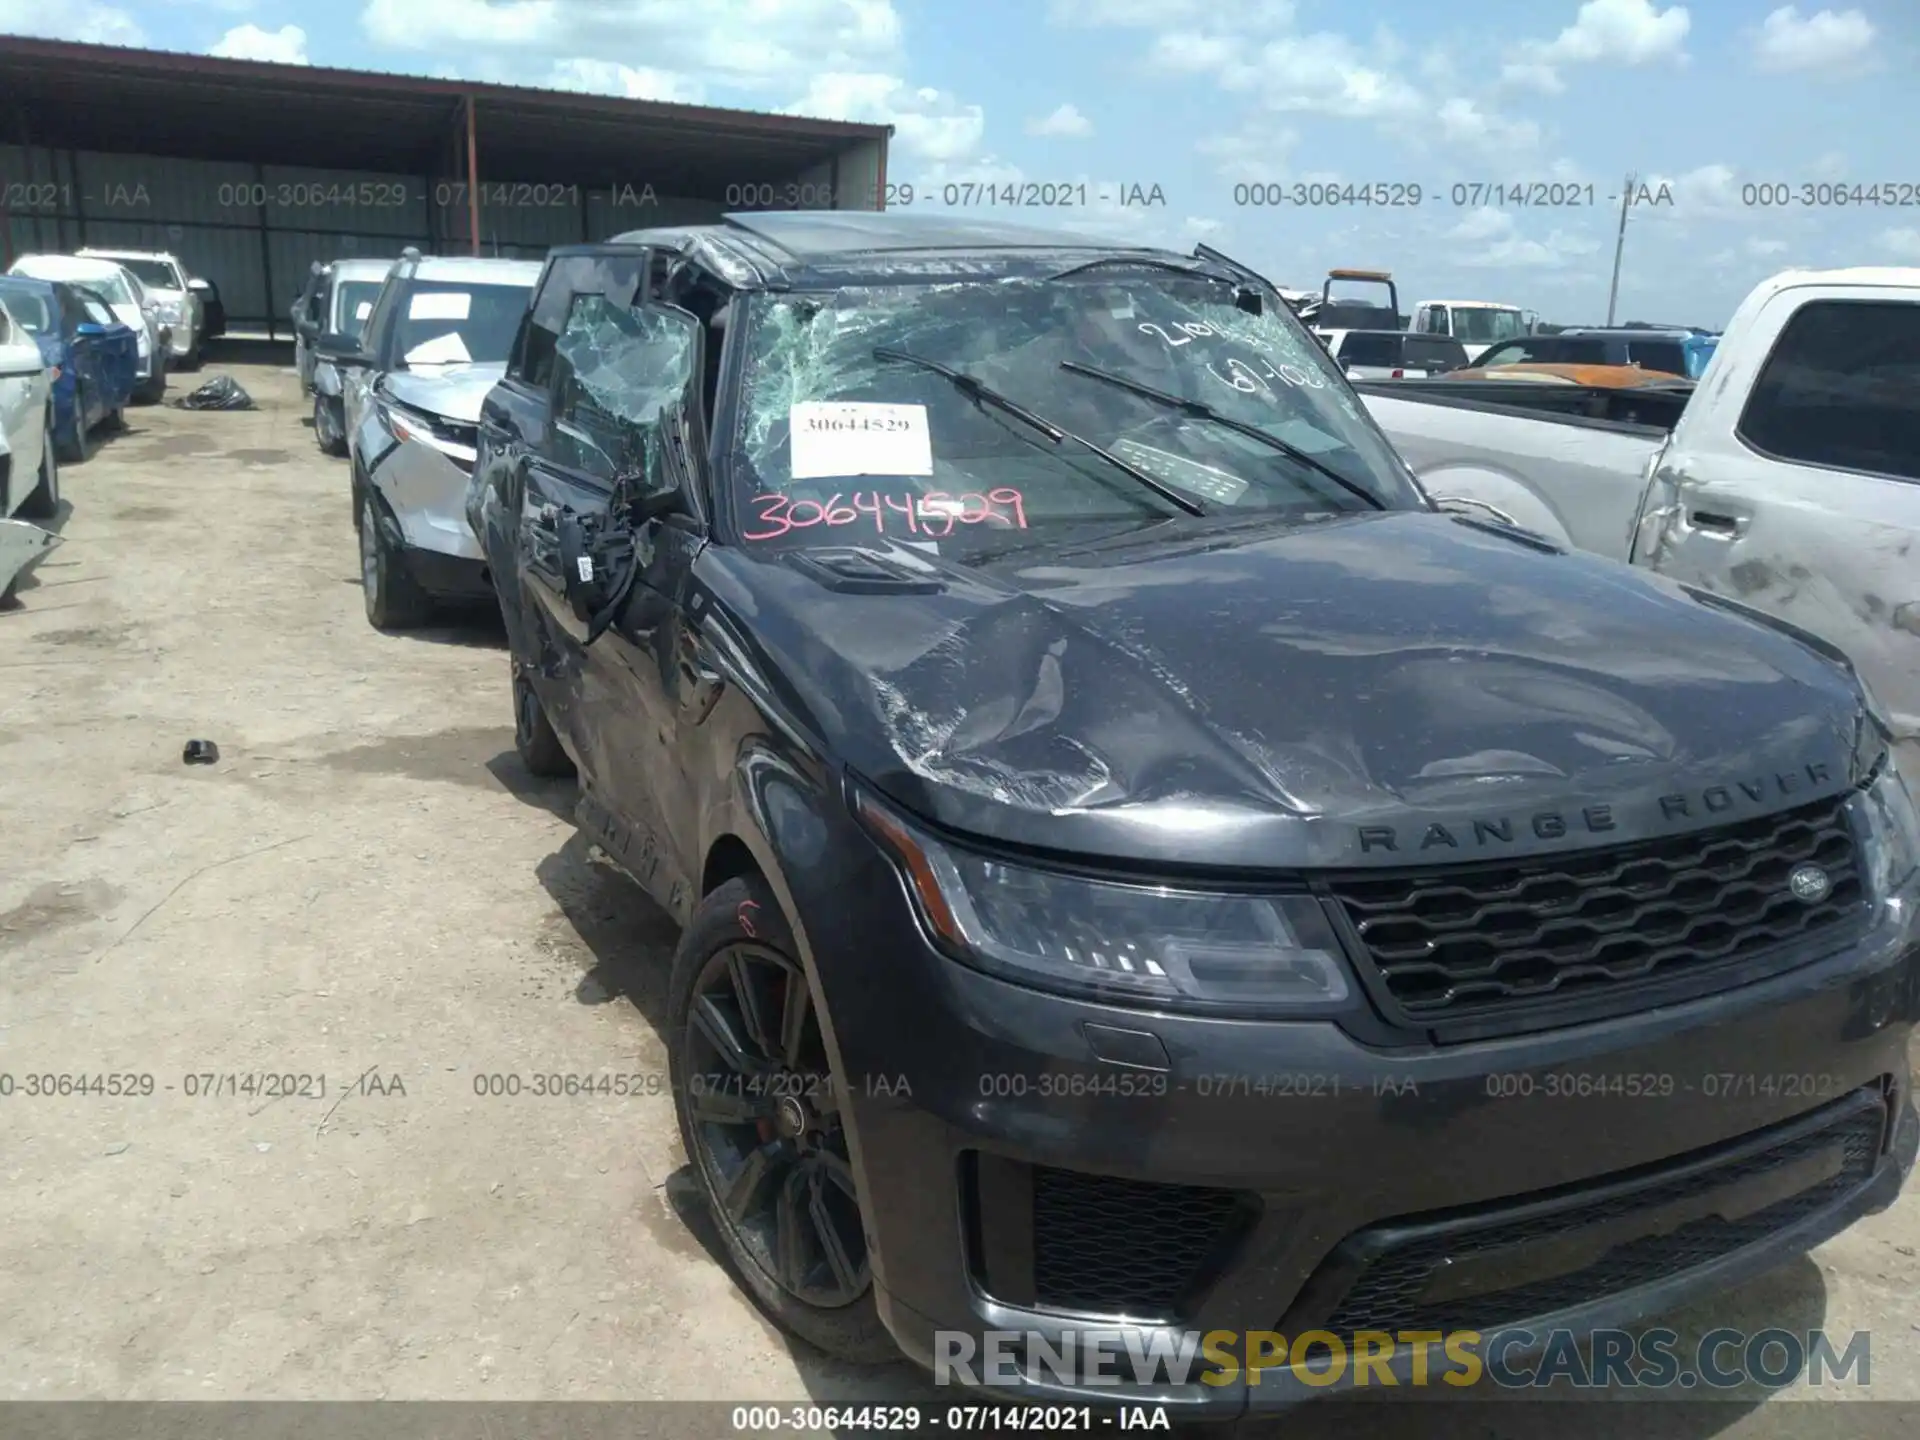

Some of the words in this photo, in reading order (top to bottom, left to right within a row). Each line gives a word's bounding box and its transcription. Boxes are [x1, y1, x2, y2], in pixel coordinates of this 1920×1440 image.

[803, 417, 911, 433] 30644529
[744, 488, 1027, 538] 30644529
[1359, 805, 1616, 852] RANGE
[1659, 762, 1832, 821] ROVER
